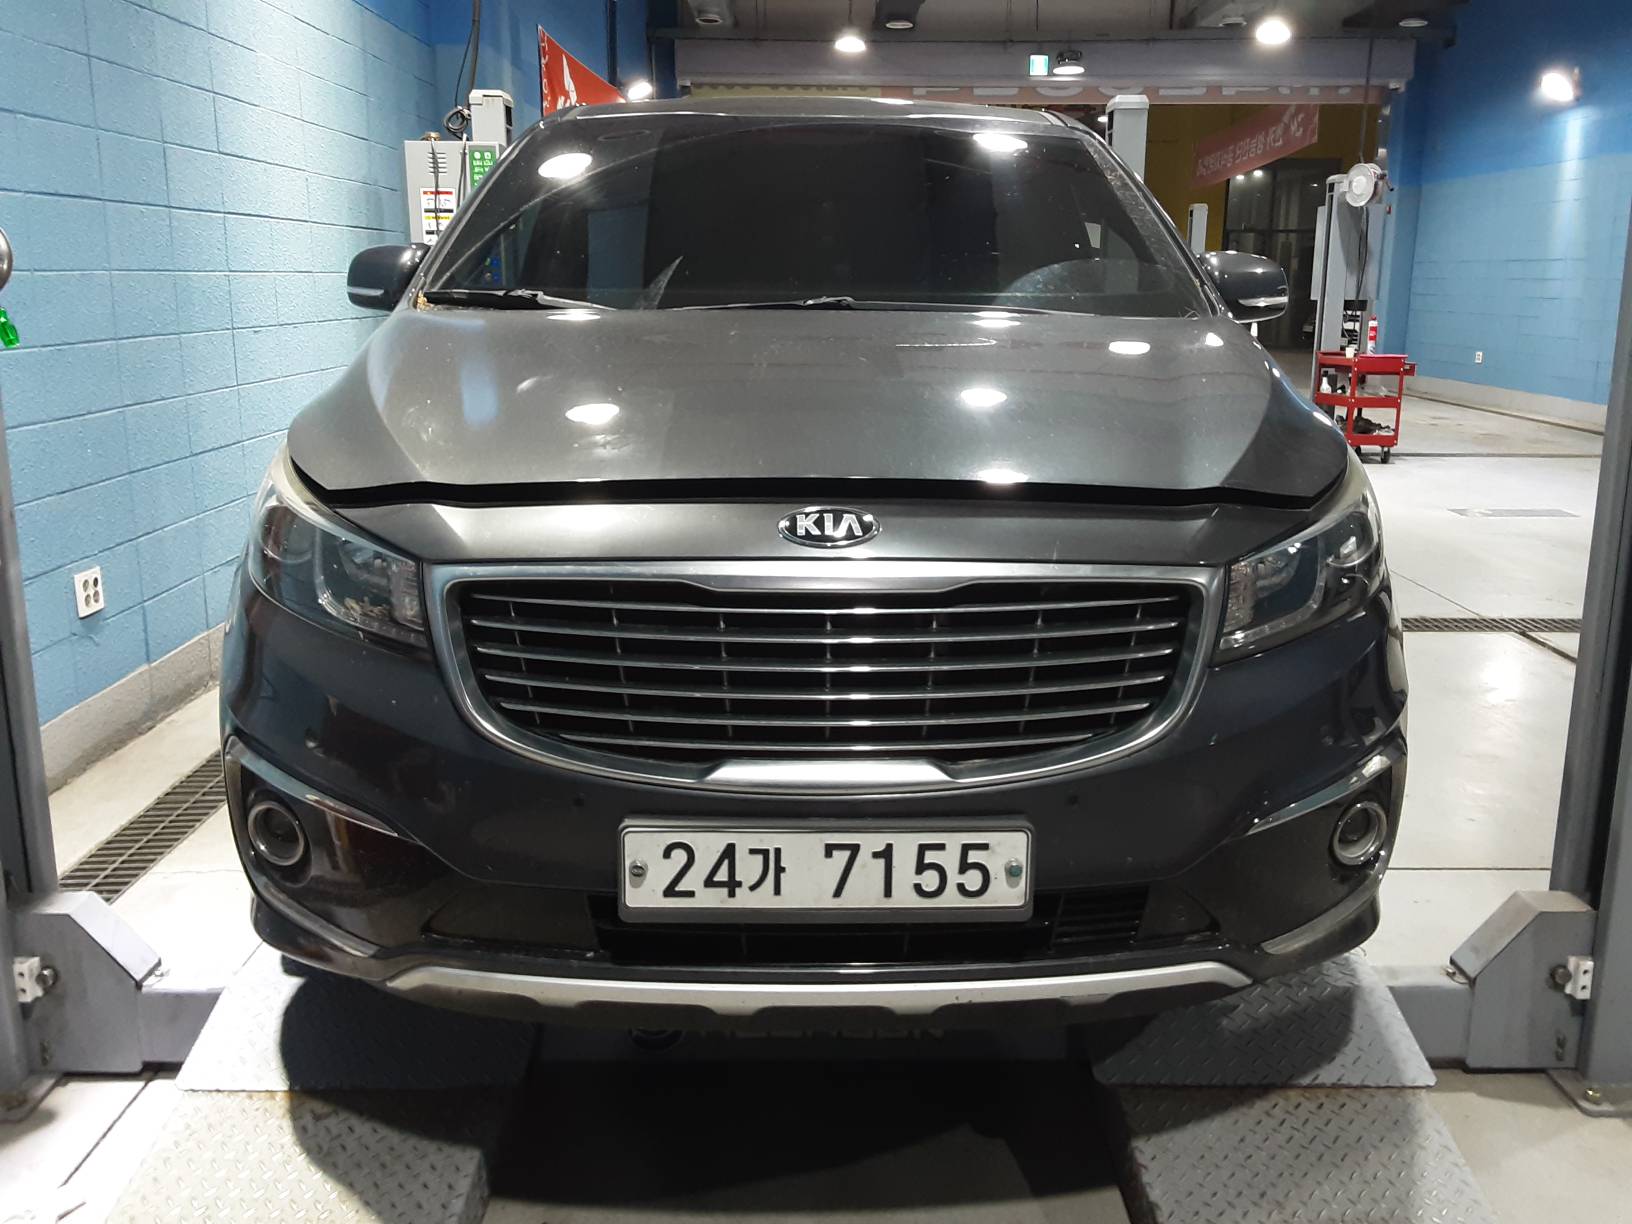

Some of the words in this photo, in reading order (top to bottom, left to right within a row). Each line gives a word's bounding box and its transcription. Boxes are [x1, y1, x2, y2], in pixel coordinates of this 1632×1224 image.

[796, 513, 863, 536] KIA
[662, 841, 786, 898] 24가
[824, 842, 991, 899] 7155
